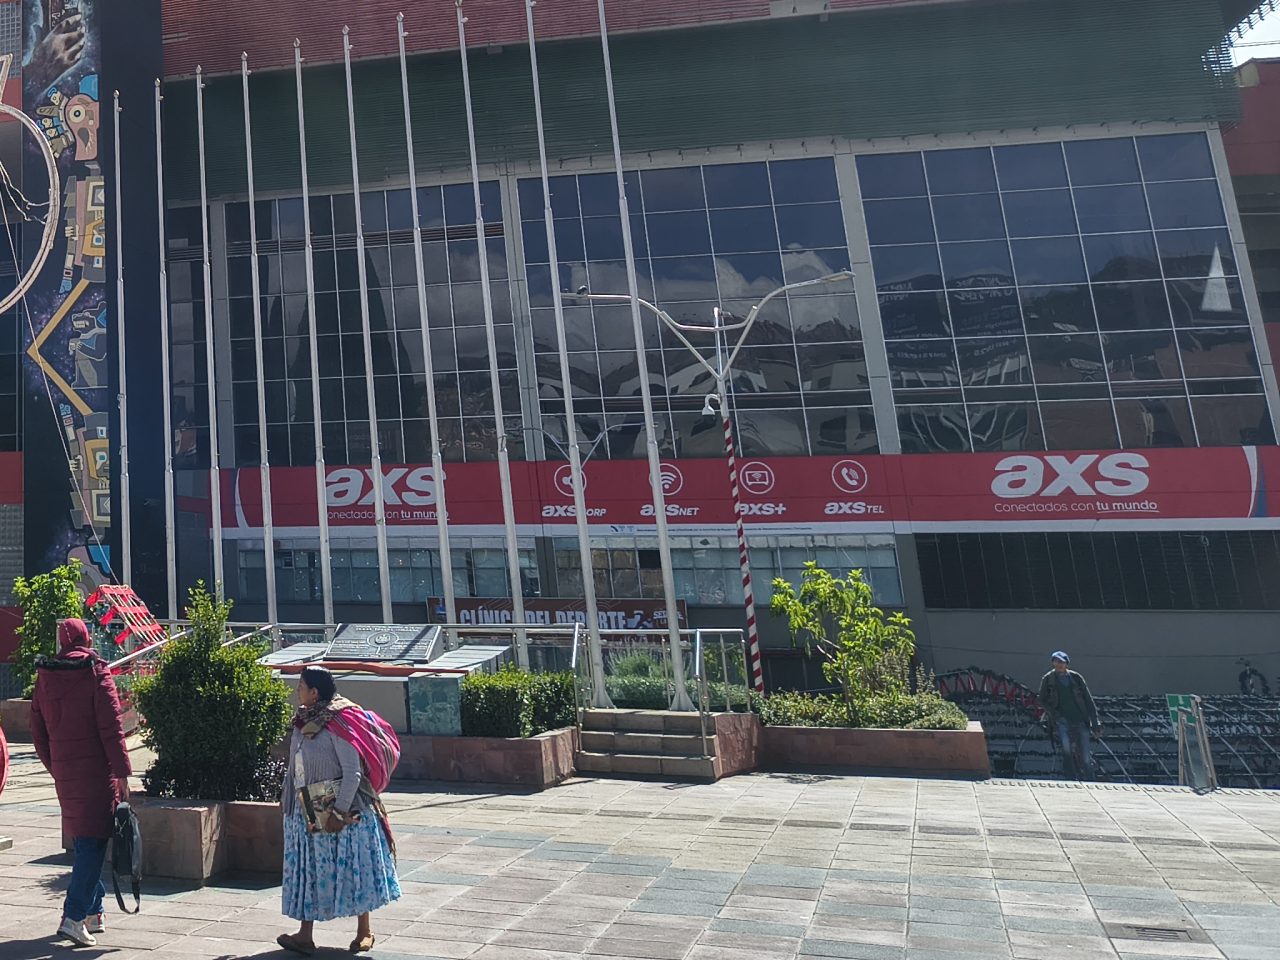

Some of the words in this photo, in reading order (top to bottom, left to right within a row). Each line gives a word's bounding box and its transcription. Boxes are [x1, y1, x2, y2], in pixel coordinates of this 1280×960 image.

[991, 452, 1149, 499] axs
[325, 466, 447, 507] axs
[542, 505, 607, 517] axsORP
[639, 504, 700, 516] asNET
[994, 502, 1067, 513] Conectados
[1071, 502, 1094, 512] con
[1096, 501, 1109, 511] tu
[1112, 500, 1157, 511] mundo
[327, 510, 376, 520] onectados
[384, 511, 399, 519] on
[401, 509, 411, 518] tu
[413, 509, 448, 518] mun
[460, 606, 516, 625] CLÍNIC
[555, 610, 626, 629] DEPRTE
